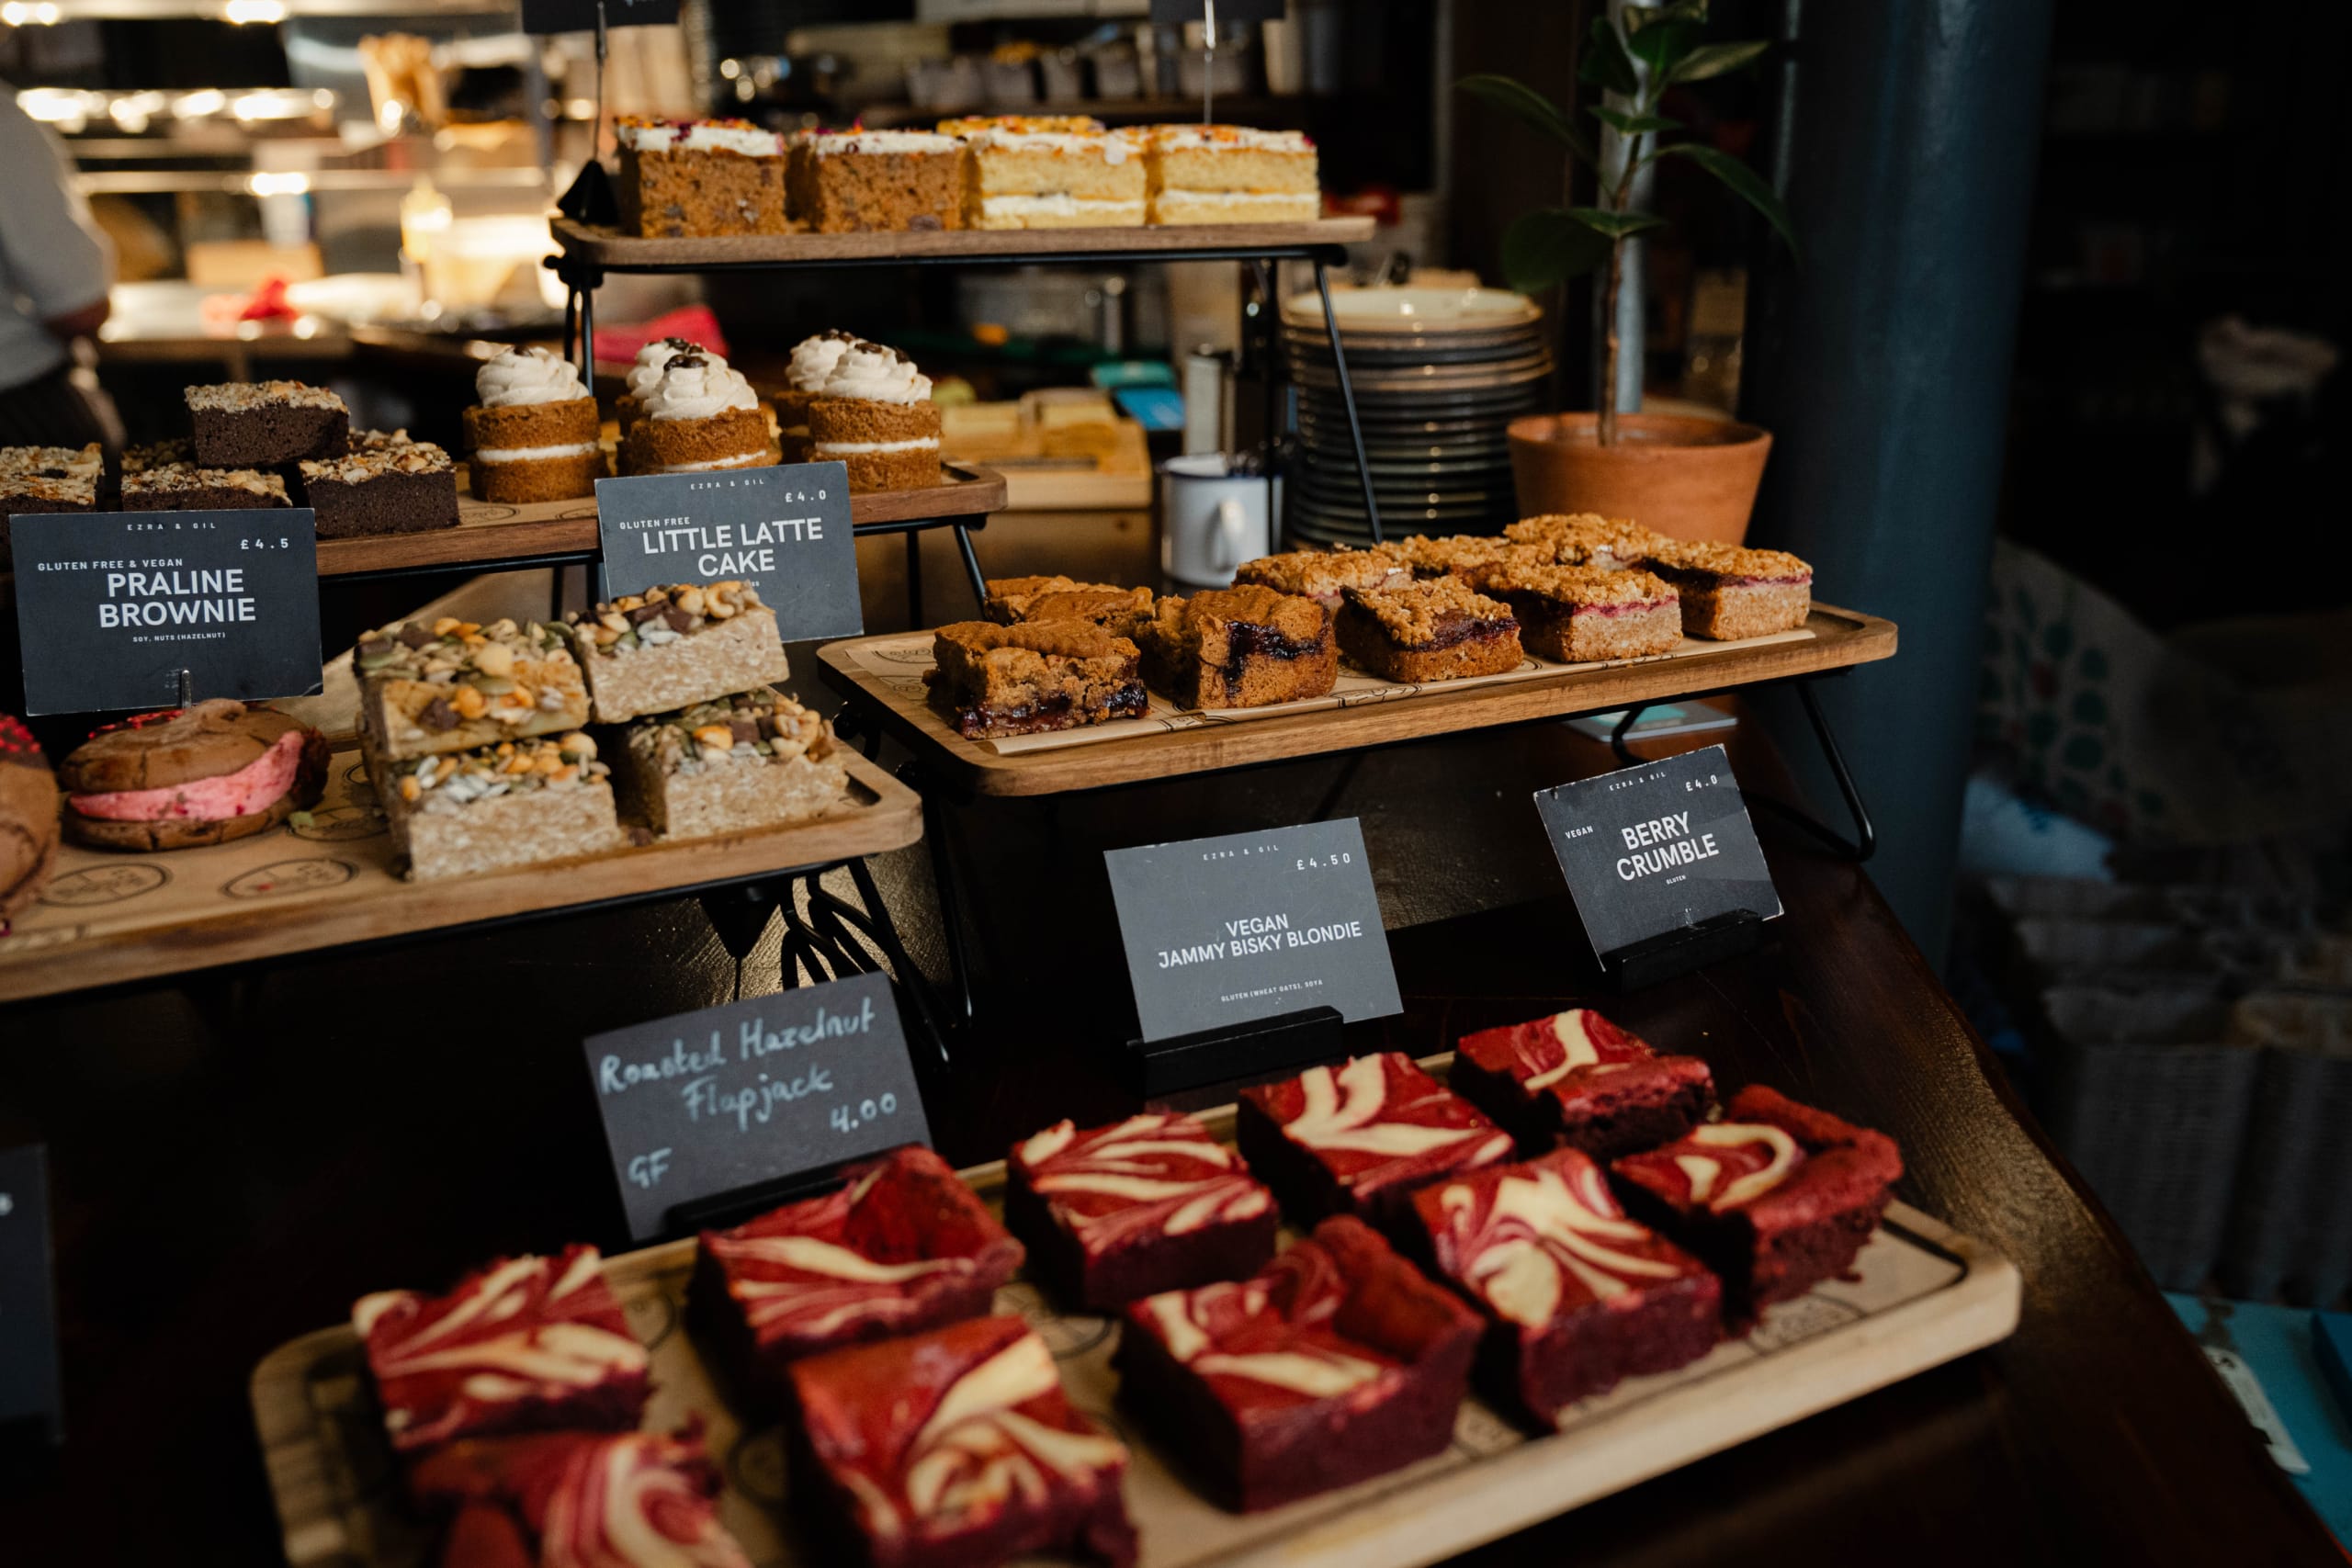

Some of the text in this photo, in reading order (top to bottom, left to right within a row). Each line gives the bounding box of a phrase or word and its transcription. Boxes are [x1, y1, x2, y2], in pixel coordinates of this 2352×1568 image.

[690, 481, 721, 491] EZRA
[785, 490, 827, 502] £4.0
[619, 516, 691, 530] GLUTEN FREE
[240, 537, 289, 550] £4.5
[642, 517, 823, 555] LITTLE LATTE
[38, 558, 184, 571] GLUTEN FREE & VEGAN
[697, 548, 775, 577] CAKE
[107, 569, 244, 598] PRALINE
[98, 598, 256, 628] BROWNIE
[177, 631, 226, 641] (HAZELNUT)
[1685, 774, 1718, 792] £4.0
[1565, 825, 1594, 840] VEGAN
[1621, 810, 1690, 851] BERRY
[1203, 851, 1235, 861] EZRA
[1296, 852, 1351, 871] £4.50
[1616, 833, 1720, 882] CRUMBLE
[1225, 913, 1290, 938] VEGAN
[1158, 920, 1363, 969] JAMMY BISKY BLONDIE
[1220, 992, 1249, 1002] GLUTEN
[1305, 979, 1323, 988] SOYA
[600, 996, 876, 1094] Roasted Hazelnut
[681, 1062, 833, 1134] Flapjack
[831, 1092, 898, 1134] 4.00
[628, 1147, 673, 1189] GF
